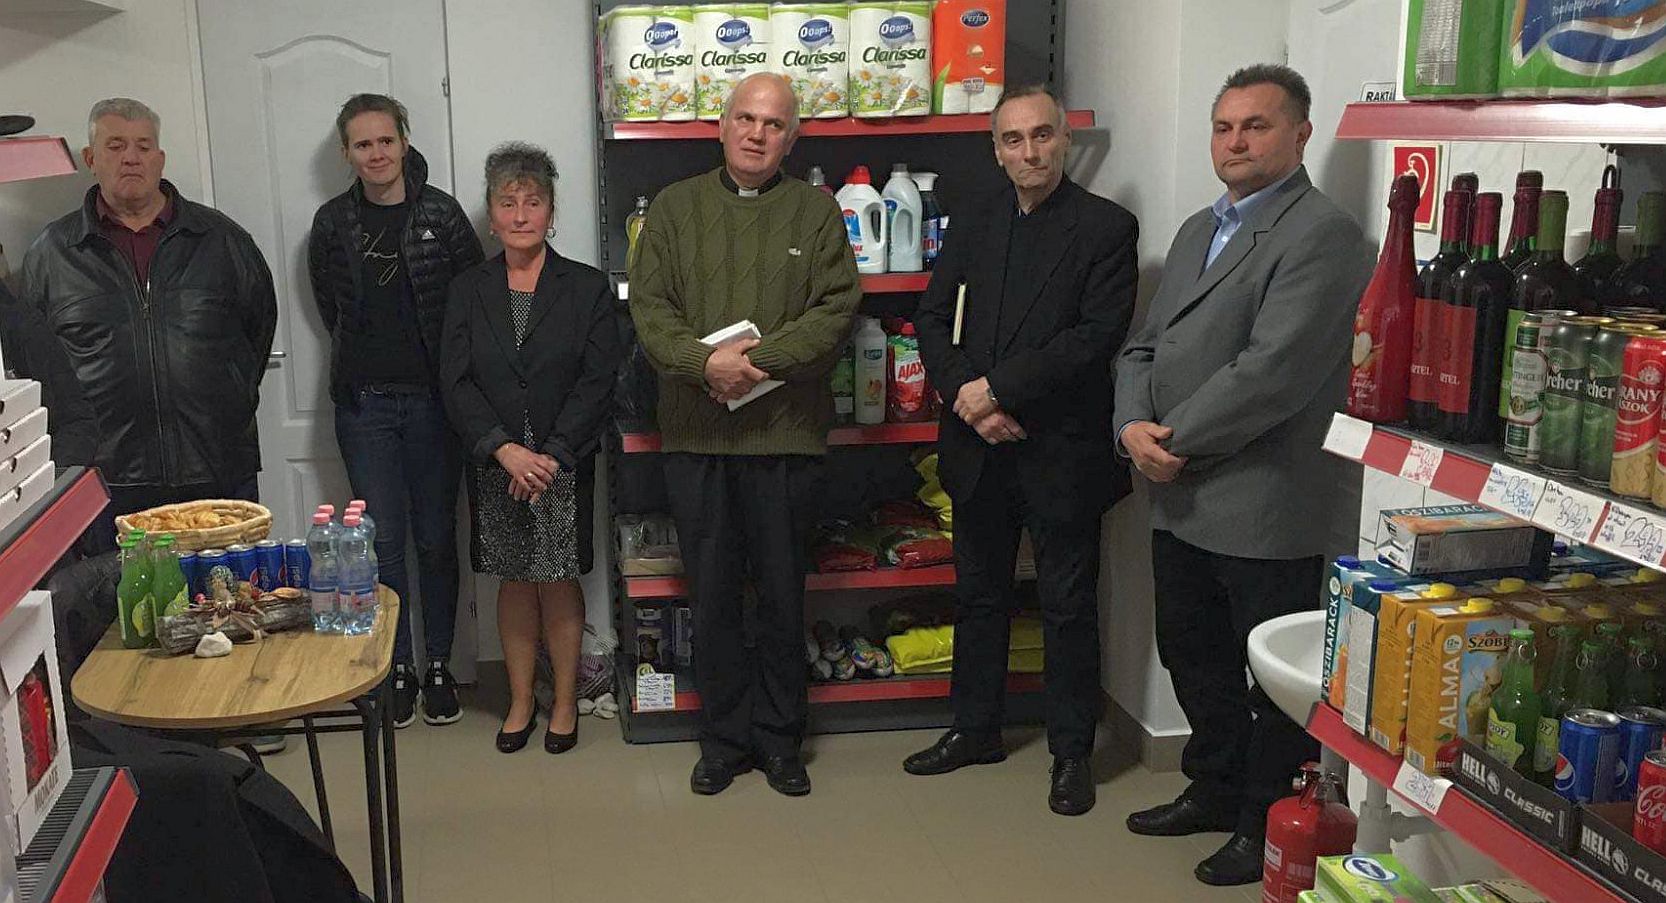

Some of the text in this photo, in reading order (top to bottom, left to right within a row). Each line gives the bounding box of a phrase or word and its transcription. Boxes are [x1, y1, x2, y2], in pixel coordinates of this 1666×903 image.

[629, 52, 693, 70] Clarissa
[701, 50, 766, 67] Clarissa
[783, 49, 846, 67] Clarissa
[863, 46, 926, 63] Clarissa
[897, 361, 924, 381] AJAX
[1546, 371, 1583, 391] reher
[1586, 379, 1616, 399] eher
[1621, 385, 1661, 402] RANY
[1619, 399, 1649, 415] SZOK
[1438, 656, 1460, 729] ALMA
[1462, 752, 1486, 783] HELL
[1504, 788, 1554, 825] CLASSIC
[1581, 825, 1612, 862] HELL
